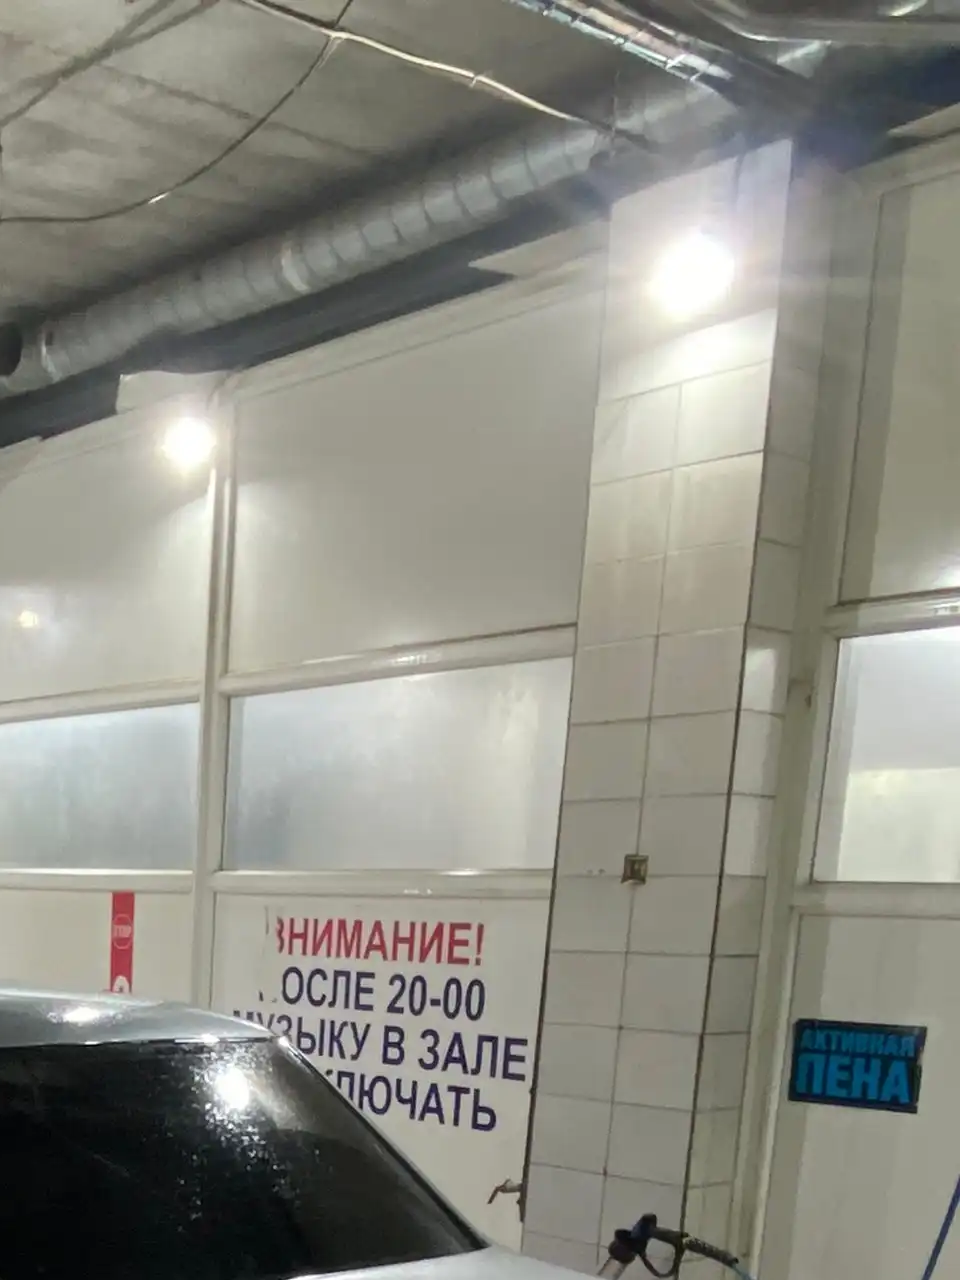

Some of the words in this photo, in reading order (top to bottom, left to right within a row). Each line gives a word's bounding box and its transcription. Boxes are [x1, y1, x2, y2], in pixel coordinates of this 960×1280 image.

[259, 965, 375, 1012] ОСЛЕ
[386, 974, 486, 1022] 20-00
[381, 1024, 406, 1066] В
[417, 1028, 529, 1082] ЗАЛЕ
[795, 1053, 911, 1104] ПЕНА
